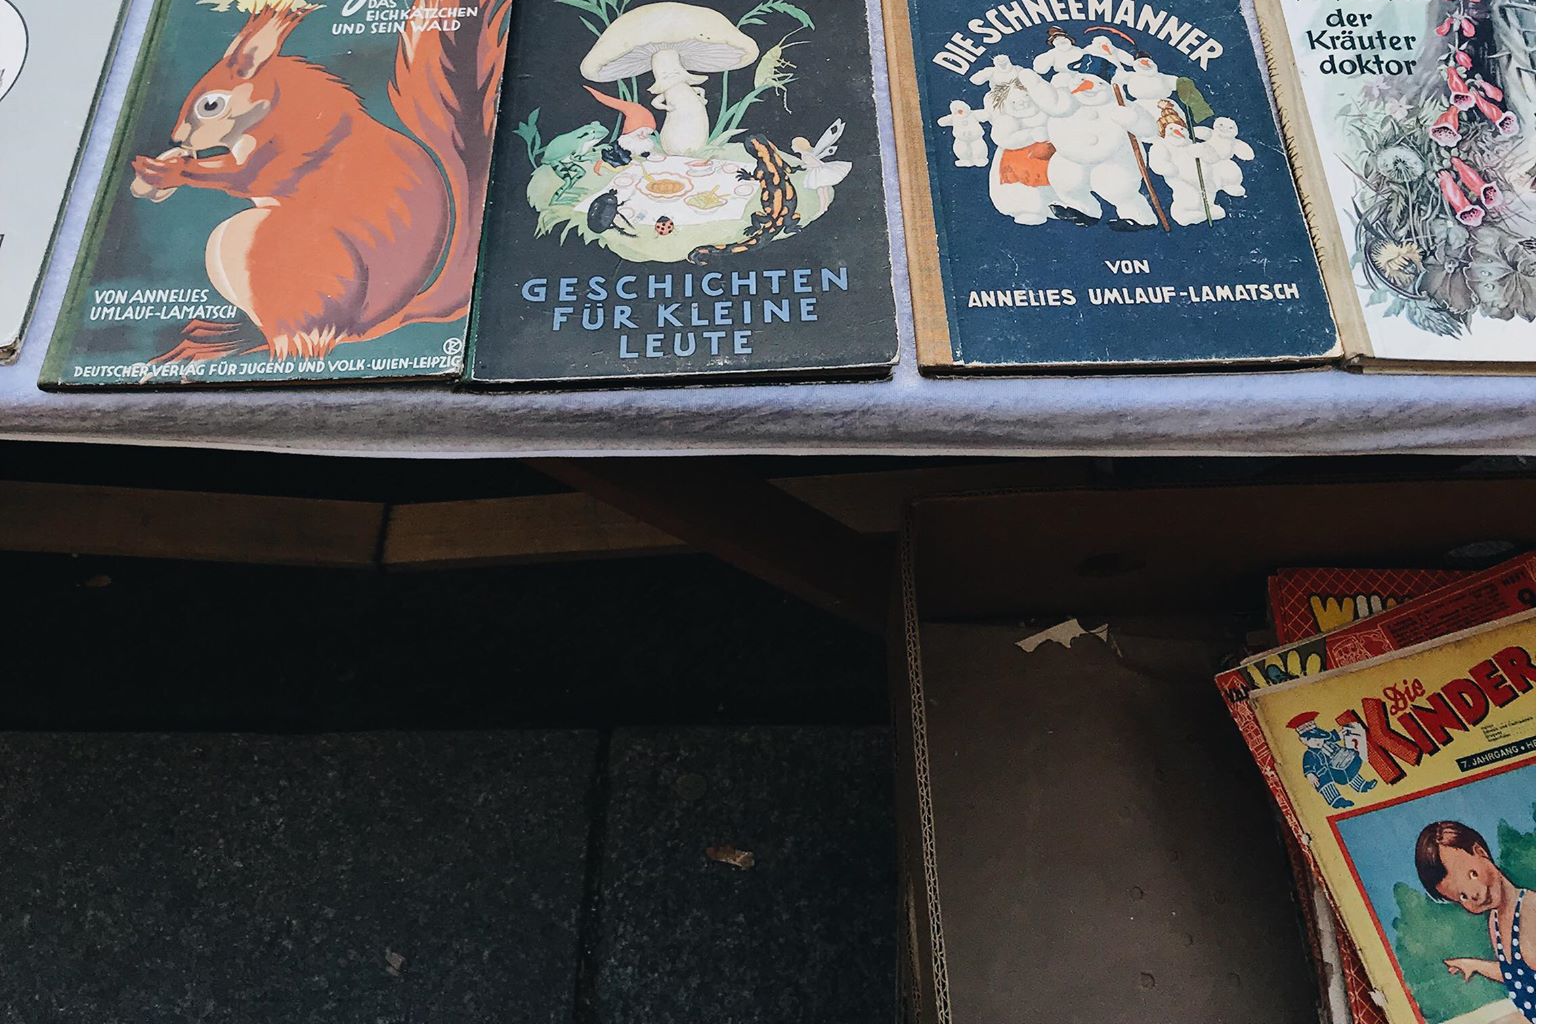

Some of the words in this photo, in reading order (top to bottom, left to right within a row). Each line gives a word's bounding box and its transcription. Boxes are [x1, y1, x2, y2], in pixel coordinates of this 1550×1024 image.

[365, 5, 479, 23] EICHKÄTZCHEN
[1325, 8, 1373, 27] der
[332, 23, 366, 36] UND
[370, 21, 406, 35] SEIN
[410, 19, 462, 33] WALD
[1306, 28, 1417, 51] Kräuter
[932, 30, 987, 76] DIE
[1319, 53, 1417, 76] doktor
[1103, 259, 1151, 275] VON
[520, 266, 849, 303] GESCHICHTEN
[94, 289, 129, 305] VON
[129, 288, 210, 304] ANNELIES
[967, 288, 1078, 309] ANNELIES
[89, 304, 238, 322] UMLAUF-LAMATSCH
[551, 303, 640, 332] FÜR
[656, 296, 820, 328] KLEINE
[618, 329, 754, 360] LEUTE
[72, 363, 150, 378] DEUTSCHER
[151, 362, 206, 378] VERLAG
[208, 359, 239, 376] FÜR
[239, 360, 297, 376] JUGEND
[297, 358, 326, 374] UND
[1382, 677, 1427, 717] Die
[1335, 646, 1536, 786] KINDER
[1471, 744, 1519, 767] JAHRGANG
